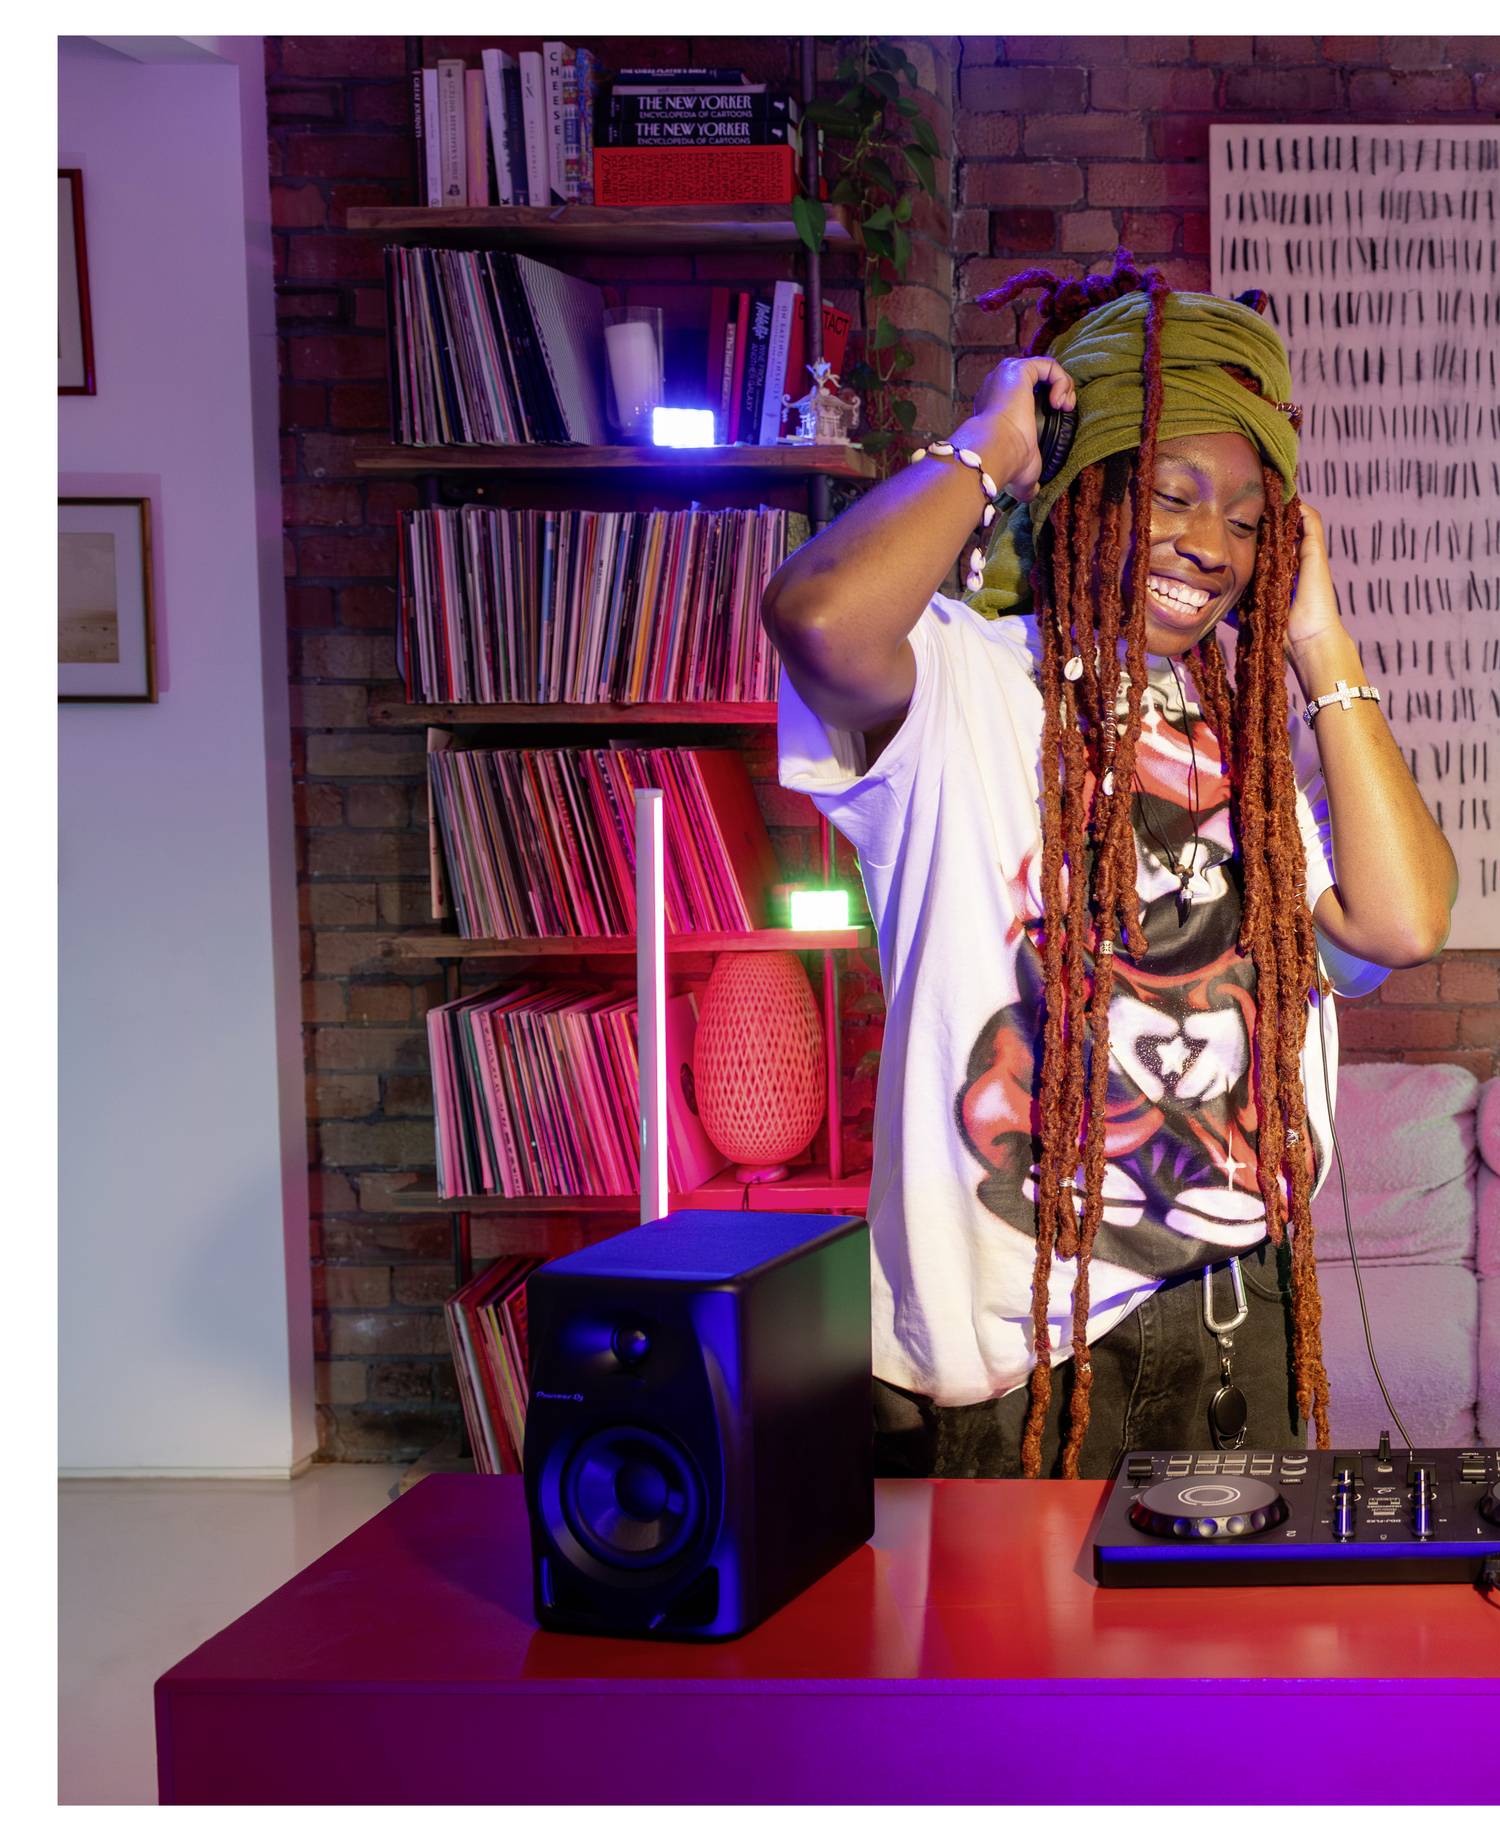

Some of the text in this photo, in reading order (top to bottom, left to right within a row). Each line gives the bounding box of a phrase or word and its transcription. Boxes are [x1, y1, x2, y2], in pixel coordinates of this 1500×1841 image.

[549, 51, 561, 136] CHEESE
[637, 95, 752, 110] THE NEW YORKER
[635, 122, 660, 136] THE
[663, 122, 696, 136] NEW
[697, 122, 750, 136] YORKER
[637, 137, 695, 145] ENCYCLOPEDIA
